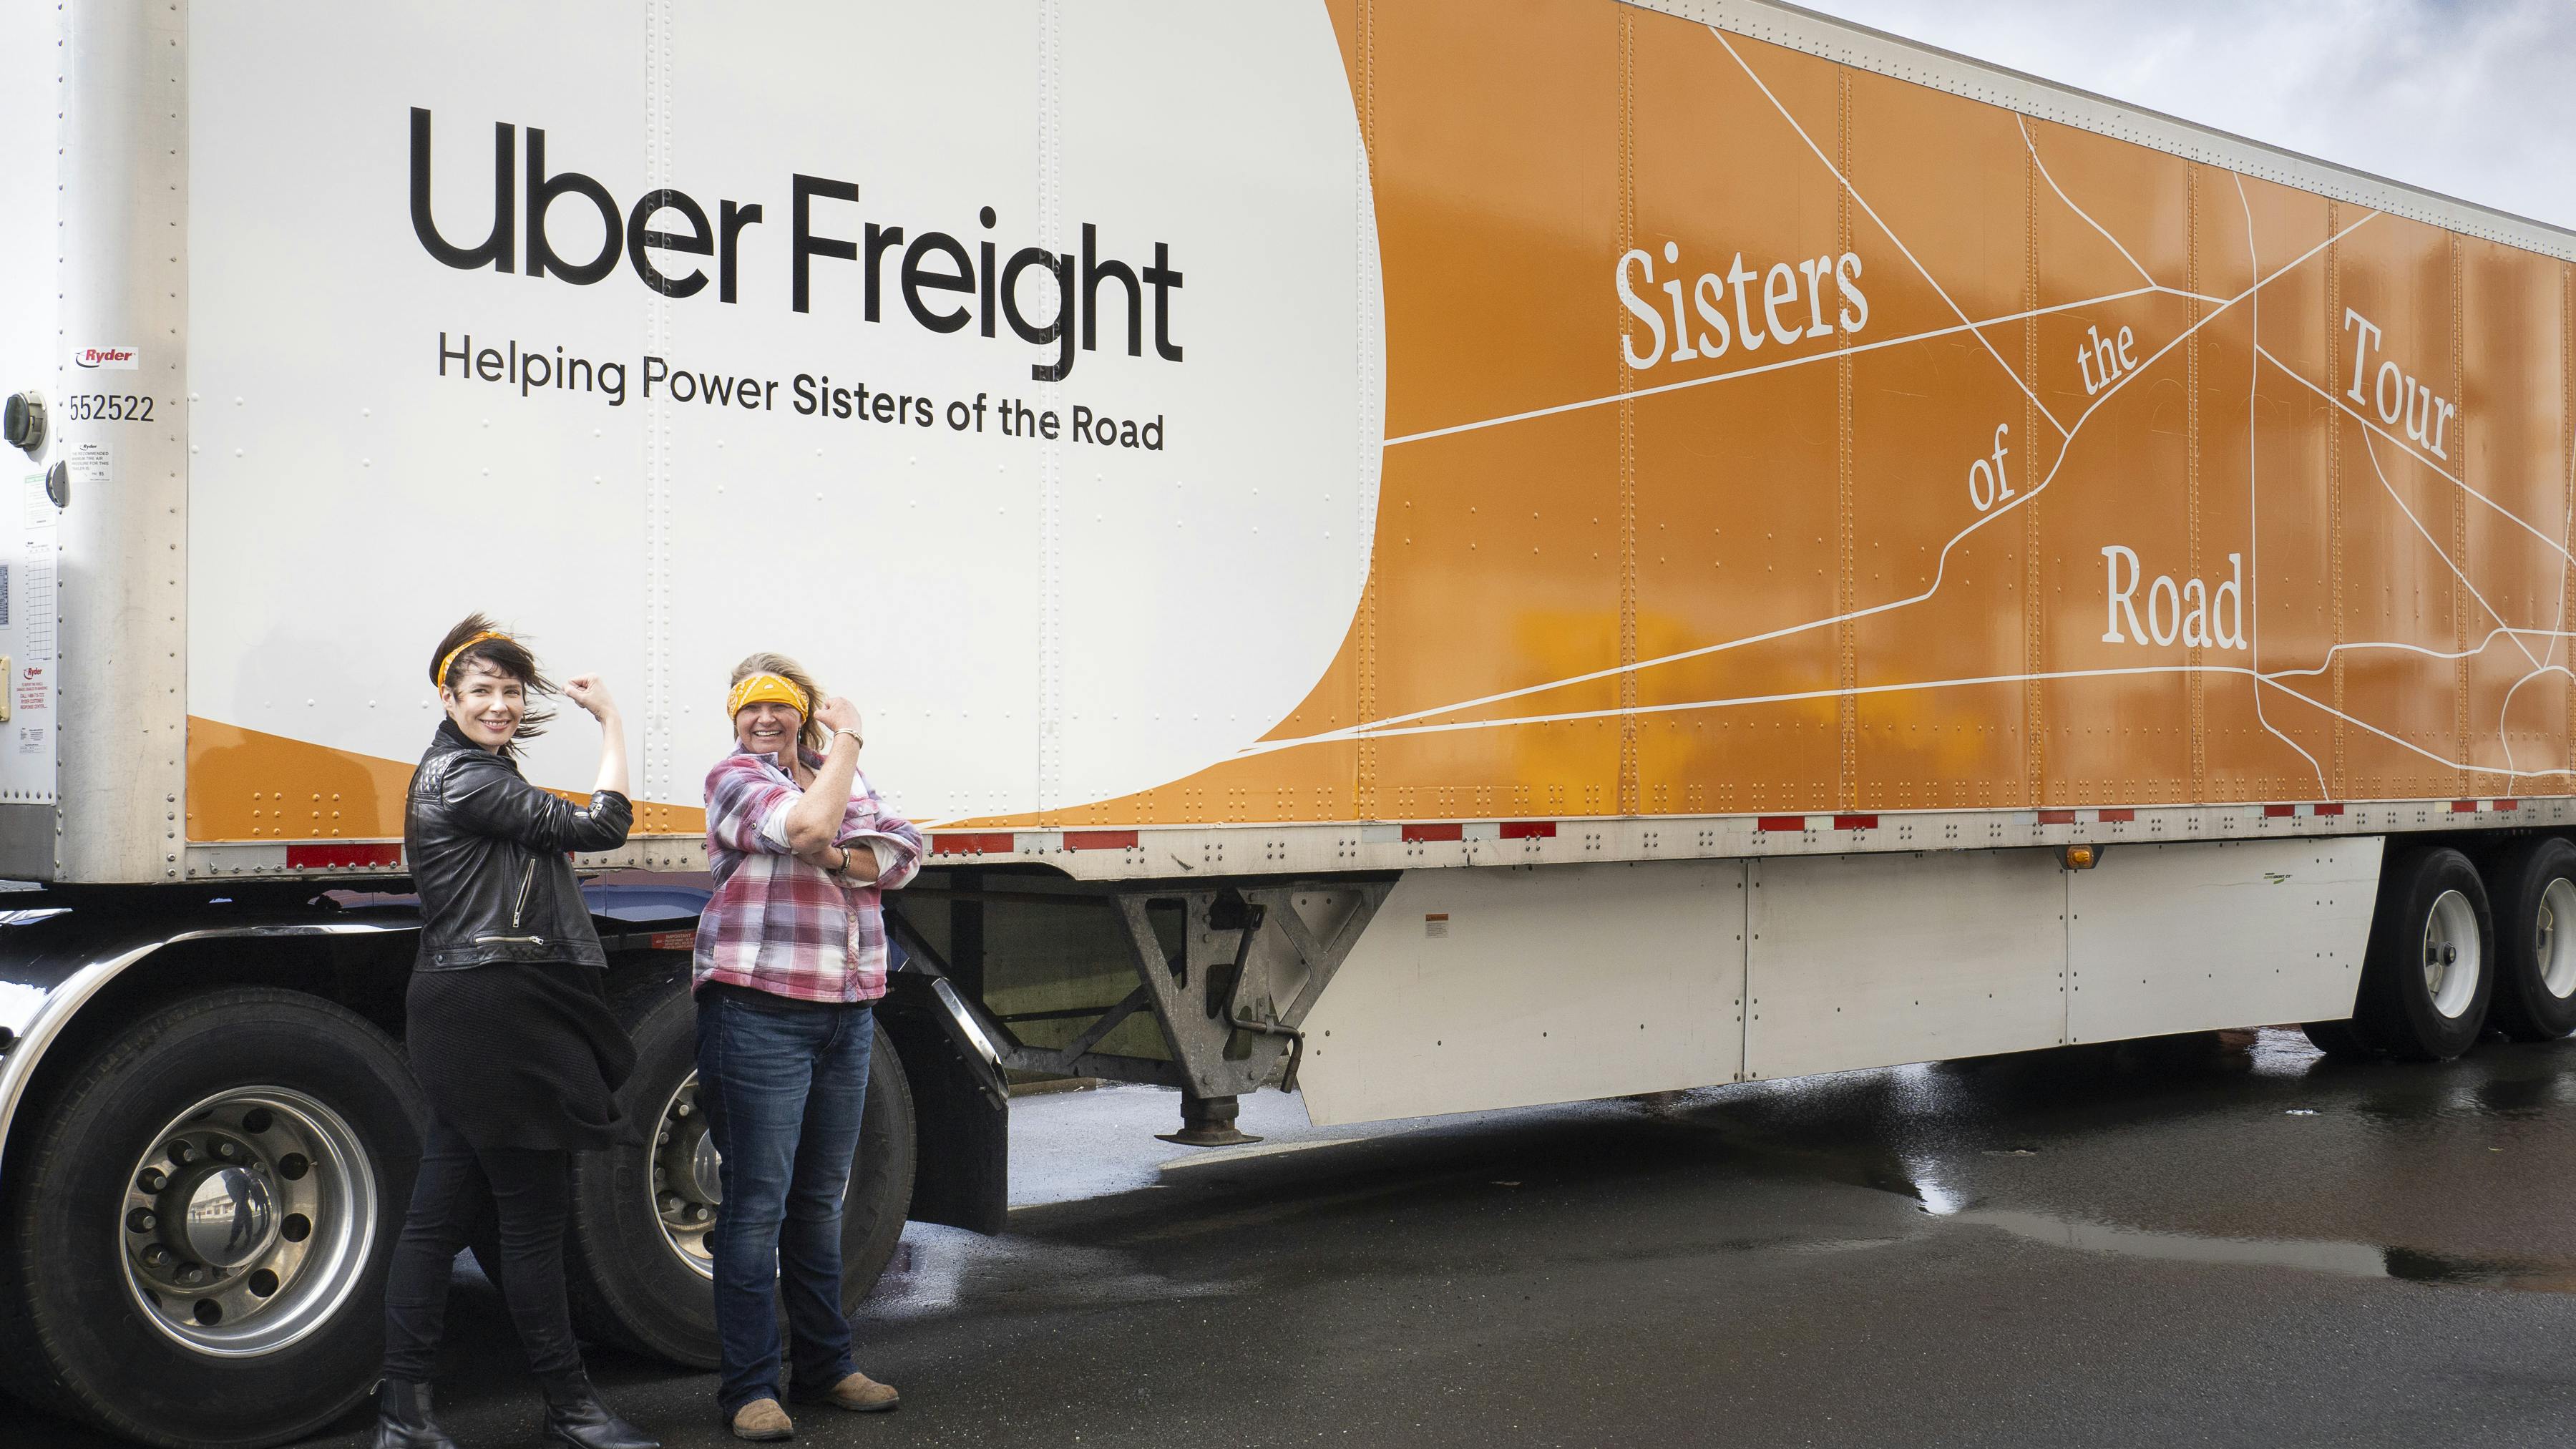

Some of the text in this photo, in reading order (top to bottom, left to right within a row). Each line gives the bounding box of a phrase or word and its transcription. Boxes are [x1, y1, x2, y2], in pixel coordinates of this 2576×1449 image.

[409, 105, 1184, 383] Uber Freight
[1615, 240, 1869, 371] Sisters
[85, 348, 133, 364] Ryder
[439, 331, 1164, 452] Helping Power Sisters of the Road
[2077, 324, 2139, 396] the
[2343, 306, 2456, 462] Tour
[69, 394, 155, 422] 552522
[1968, 422, 2016, 512] of
[2100, 544, 2249, 651] Road
[28, 667, 43, 677] Ryder
